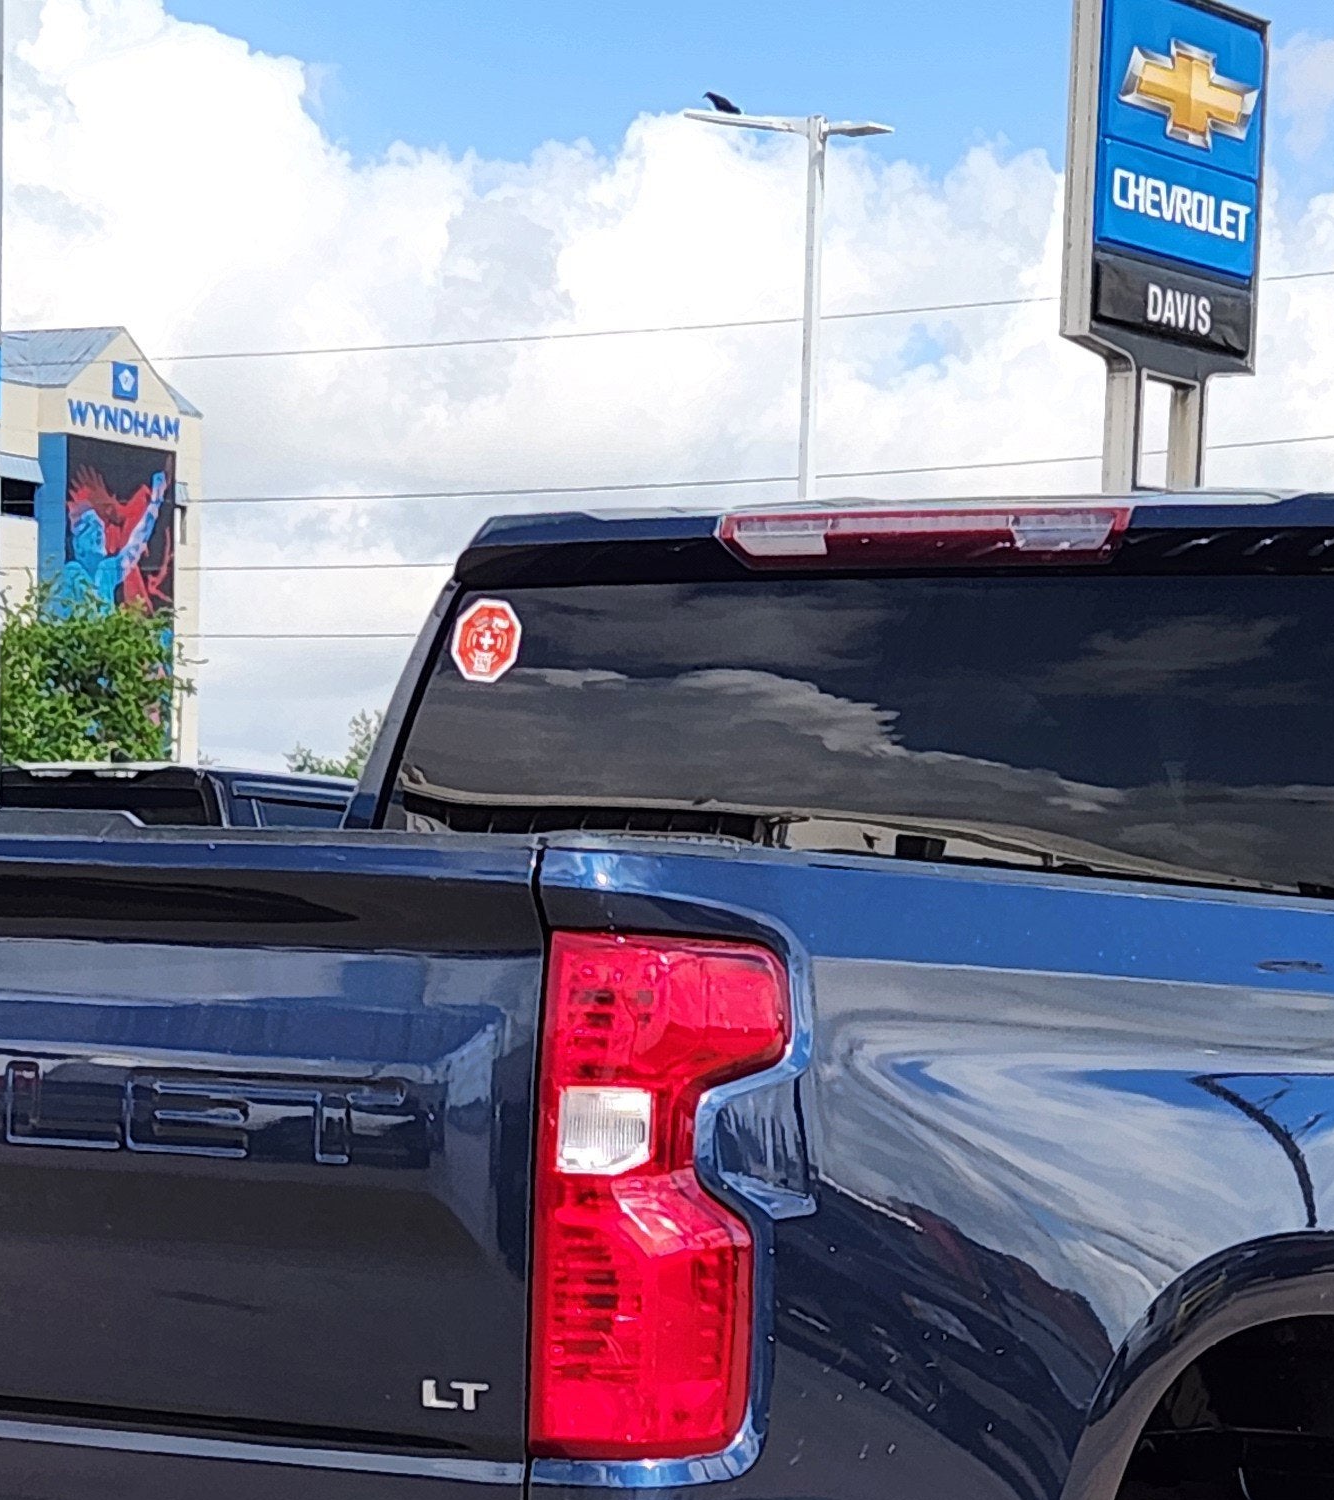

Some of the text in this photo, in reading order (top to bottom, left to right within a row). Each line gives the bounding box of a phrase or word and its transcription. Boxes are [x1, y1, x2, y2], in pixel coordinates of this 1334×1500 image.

[1113, 168, 1252, 243] CHEVROLET
[1146, 283, 1212, 336] DAVIS
[68, 399, 180, 442] WYNDHAM
[422, 1380, 489, 1411] LT
